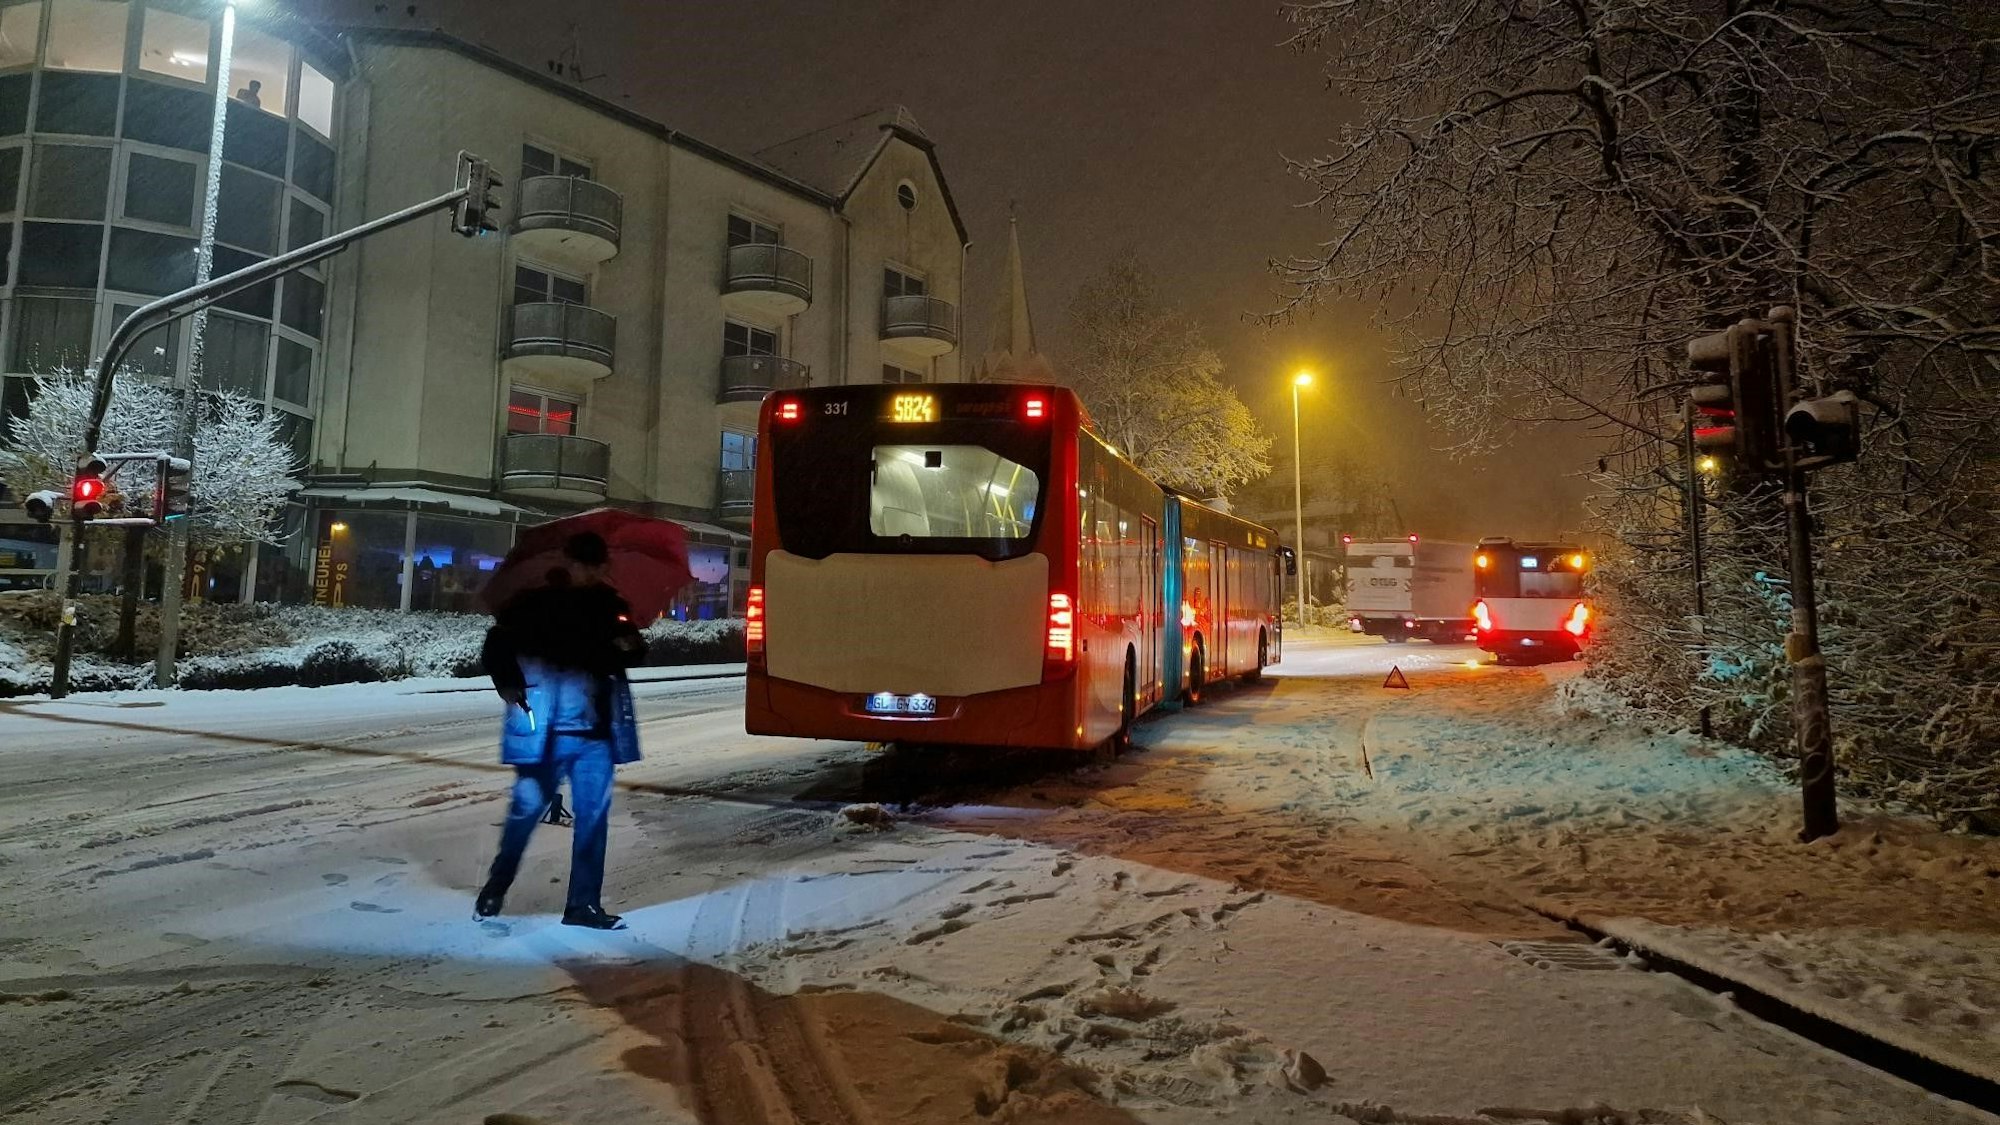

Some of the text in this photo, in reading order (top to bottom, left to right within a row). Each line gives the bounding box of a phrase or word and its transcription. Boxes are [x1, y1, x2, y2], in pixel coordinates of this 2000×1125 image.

[824, 401, 849, 415] 331
[894, 395, 932, 422] SB24
[873, 697, 889, 709] GL
[912, 698, 935, 711] 336
